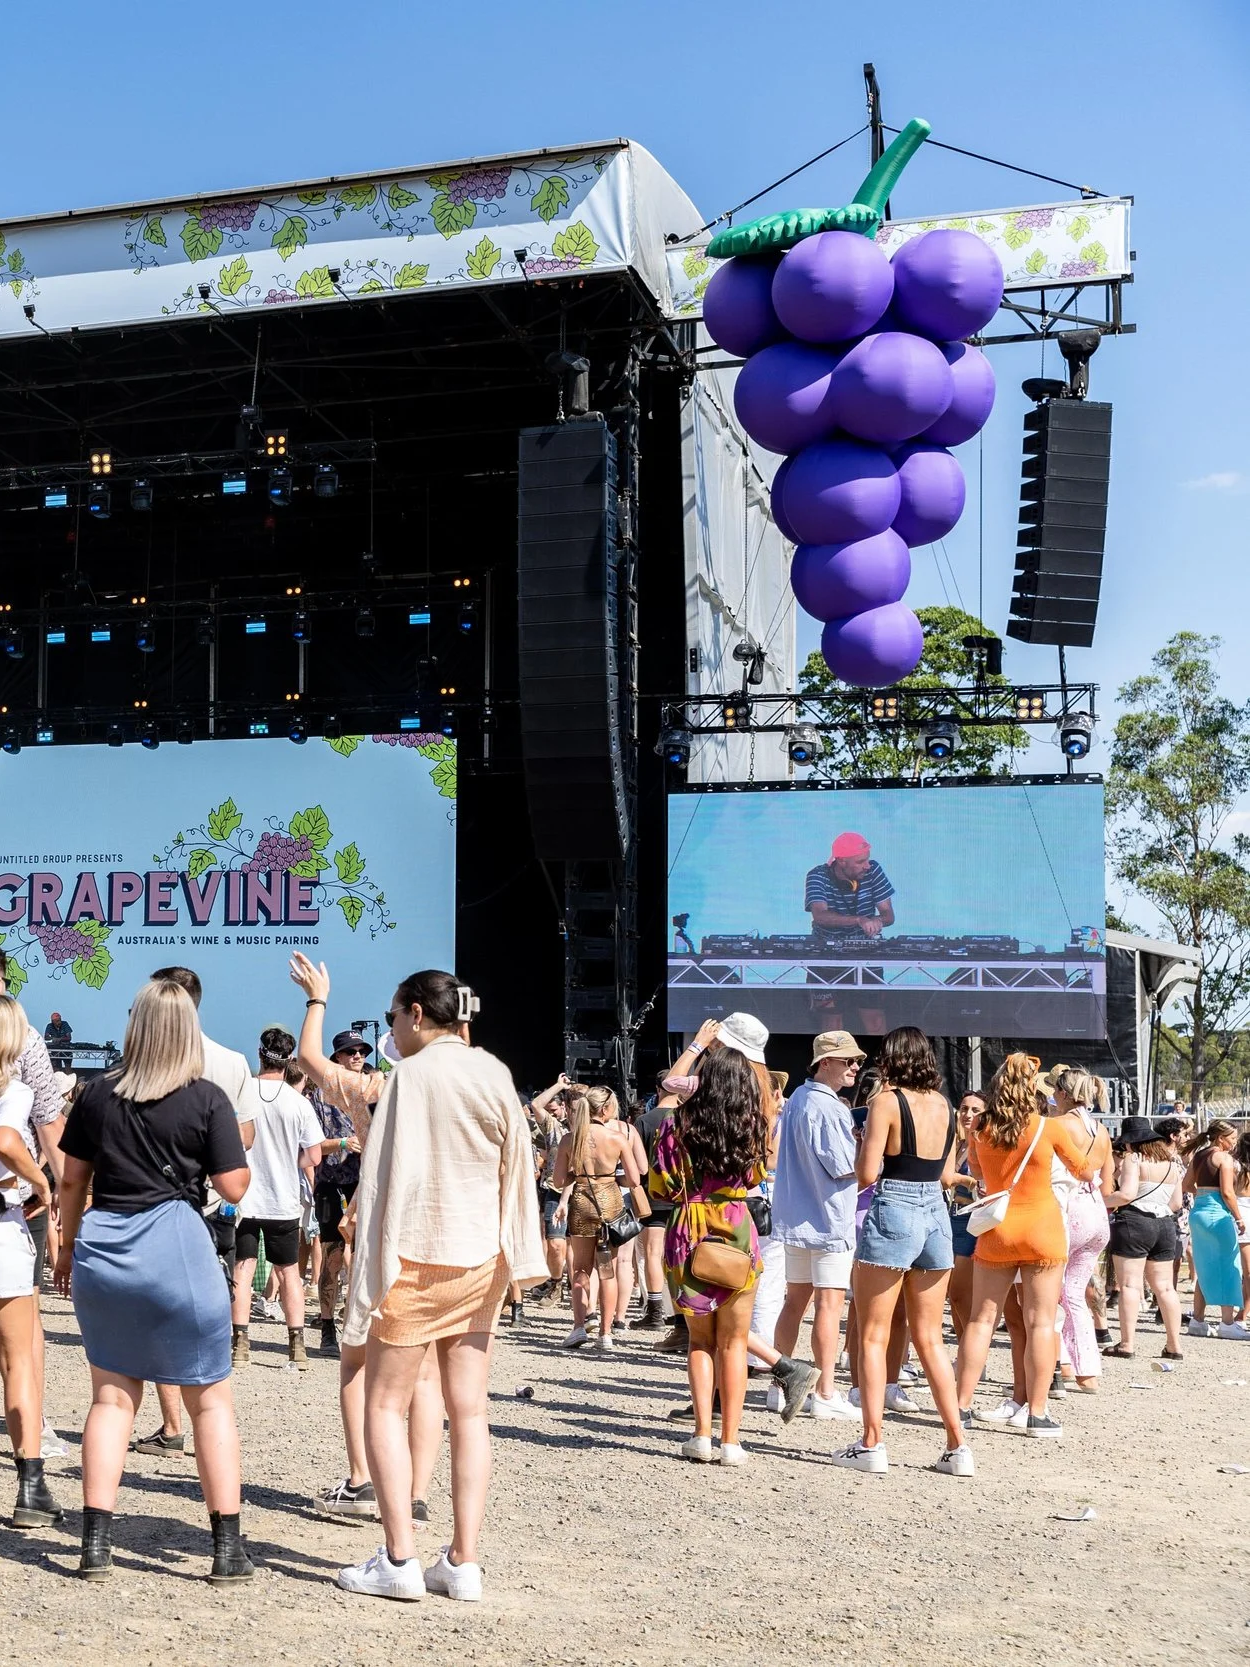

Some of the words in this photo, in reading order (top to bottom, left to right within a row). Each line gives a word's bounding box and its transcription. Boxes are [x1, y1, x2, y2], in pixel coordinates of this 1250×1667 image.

[42, 854, 72, 864] GROUP
[75, 853, 123, 863] PRESENTS
[117, 935, 186, 945] AUSTRALIA'S
[190, 936, 219, 945] WINE
[224, 936, 231, 945] &
[236, 936, 271, 945] MUSIC
[275, 936, 319, 945] PAIRING
